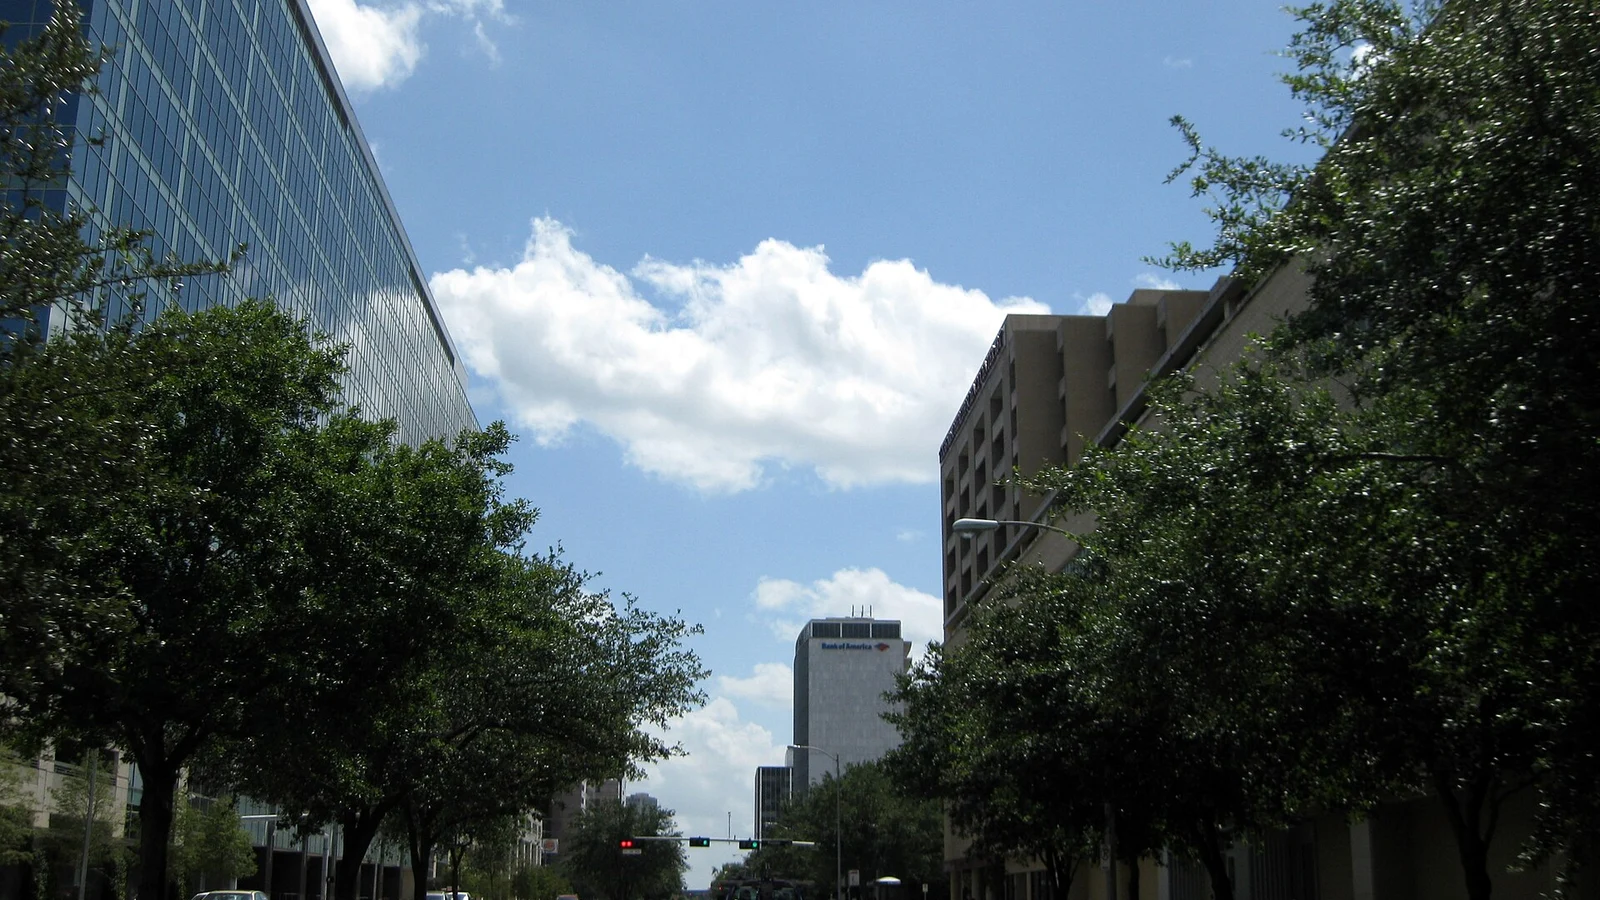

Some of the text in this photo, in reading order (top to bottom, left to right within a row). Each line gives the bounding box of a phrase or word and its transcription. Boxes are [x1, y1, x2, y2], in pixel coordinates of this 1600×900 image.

[821, 642, 872, 650] Bank of America
